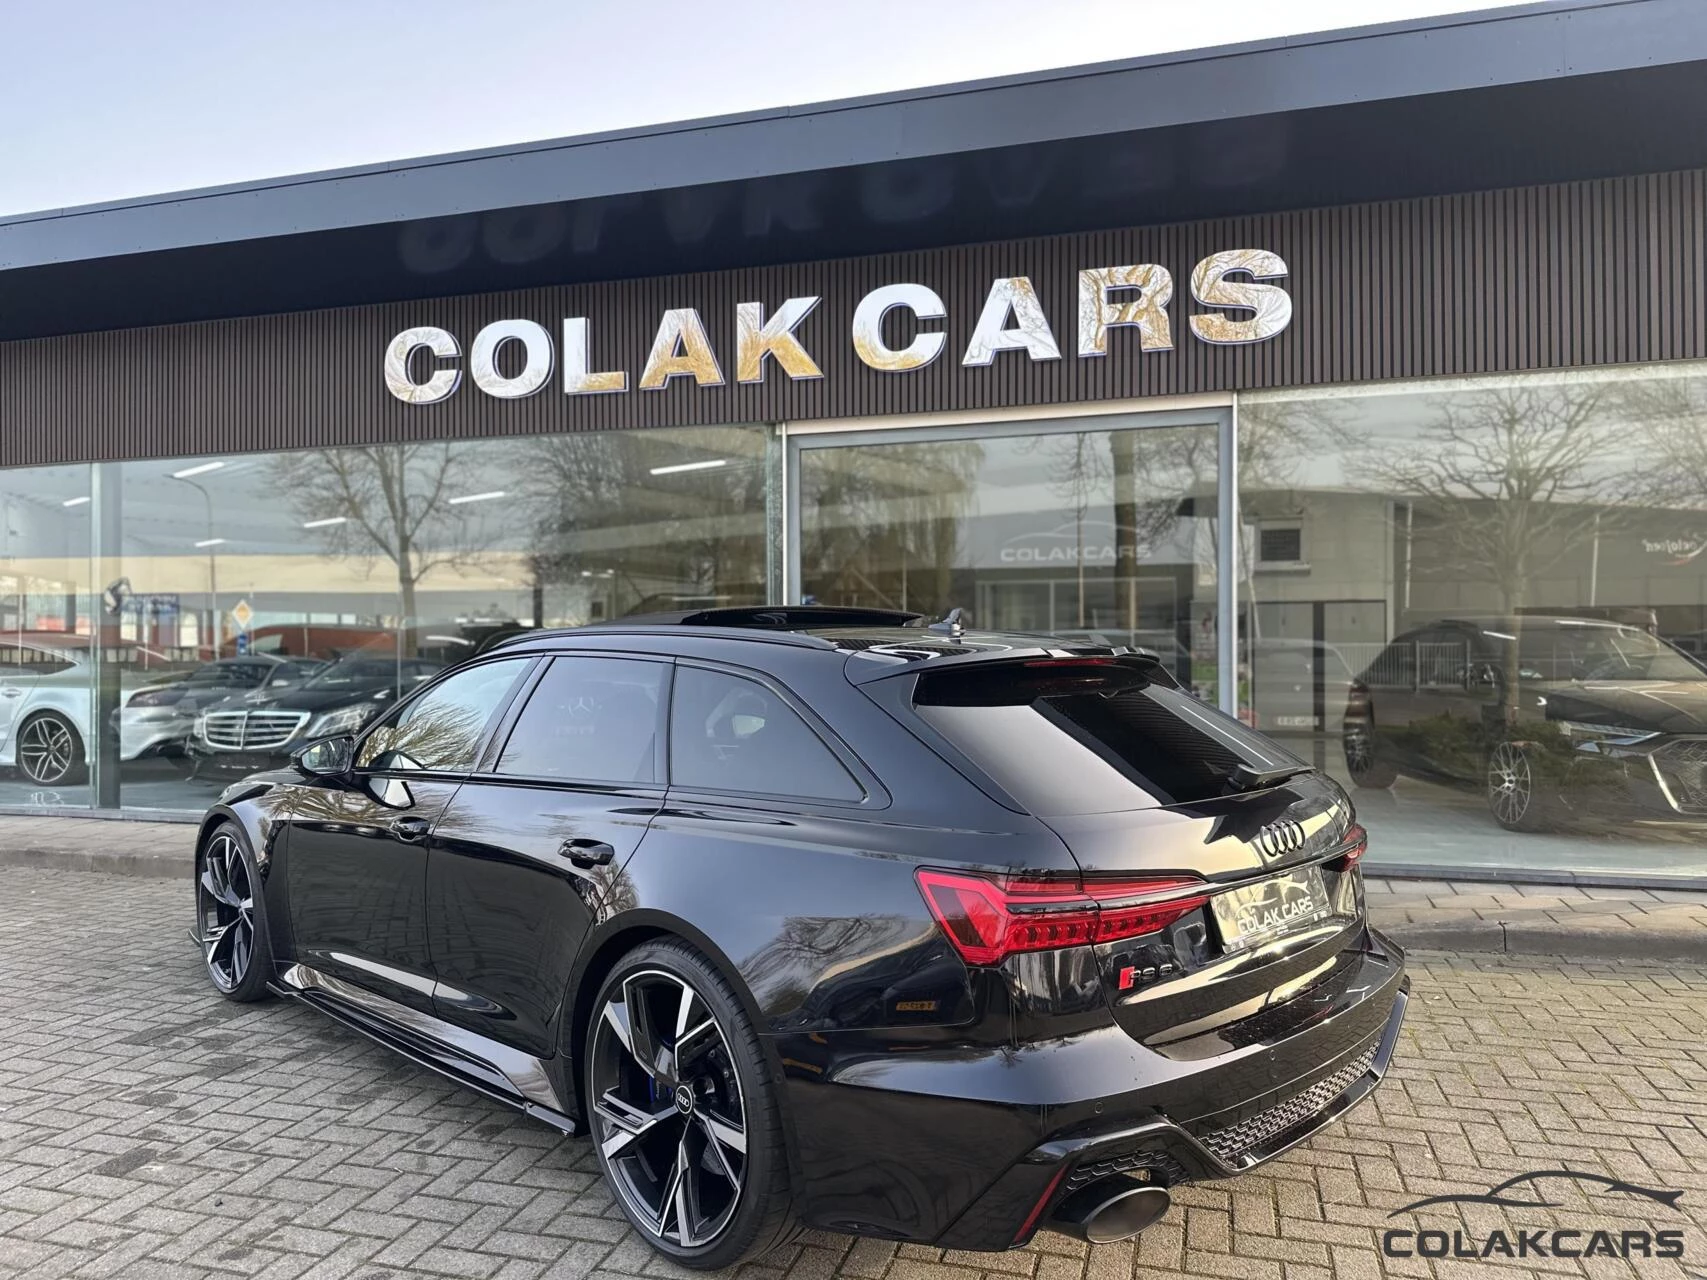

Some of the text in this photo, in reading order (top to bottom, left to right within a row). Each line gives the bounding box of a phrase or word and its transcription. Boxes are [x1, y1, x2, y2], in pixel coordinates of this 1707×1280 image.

[384, 248, 1293, 405] COLAK CARS
[1000, 544, 1152, 562] COLAKCARS
[1237, 906, 1279, 935] COLAK
[1281, 896, 1314, 919] CARS
